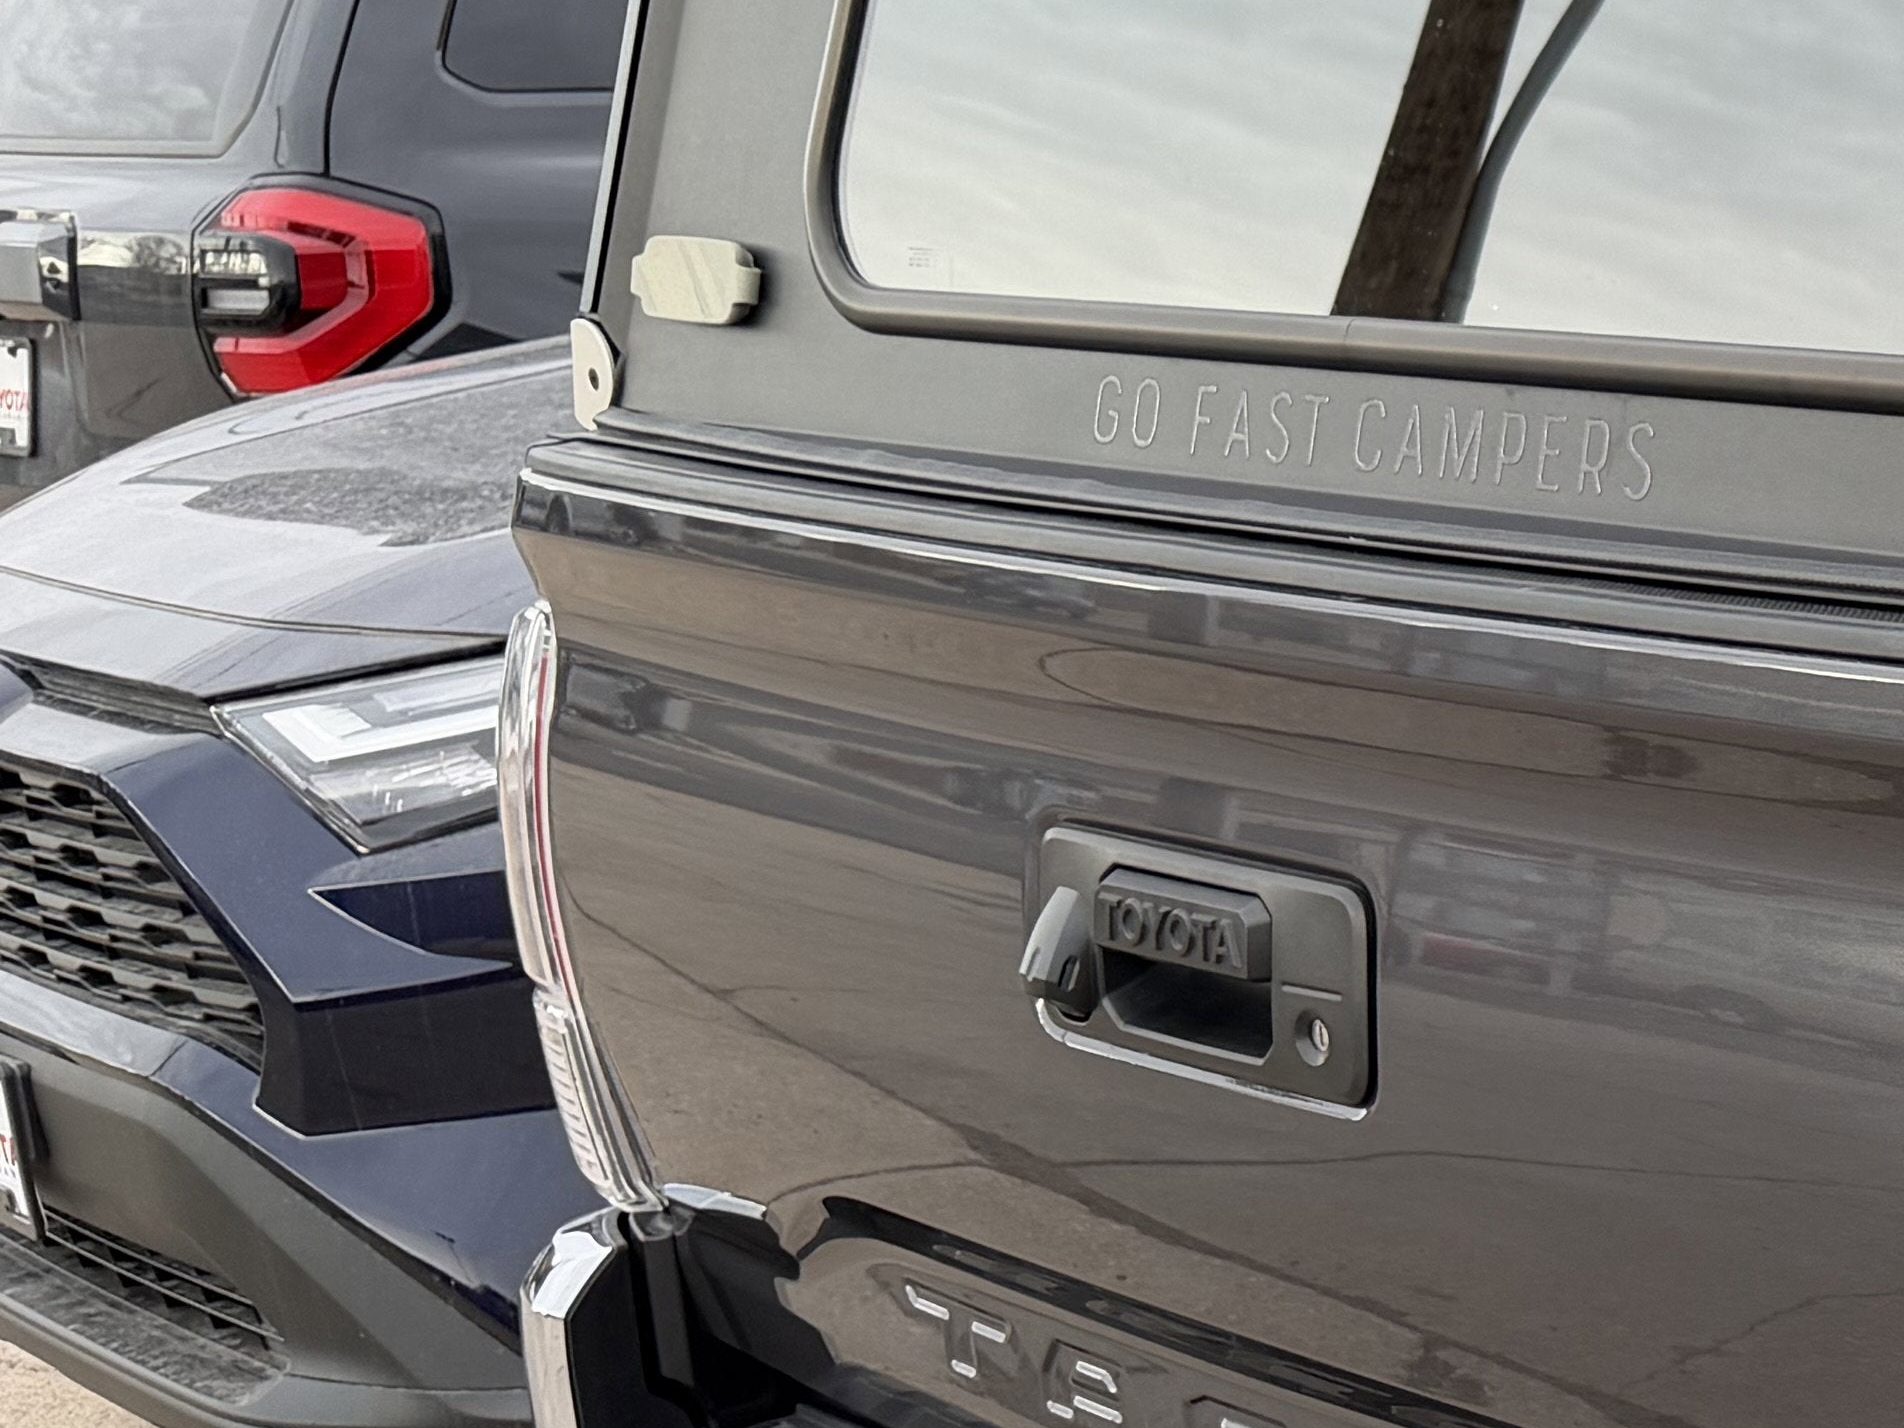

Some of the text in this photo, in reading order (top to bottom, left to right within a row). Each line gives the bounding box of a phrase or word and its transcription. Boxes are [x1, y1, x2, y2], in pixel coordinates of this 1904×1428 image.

[1094, 376, 1656, 502] GO FAST CAMPERS
[1098, 893, 1243, 969] TOYOTA
